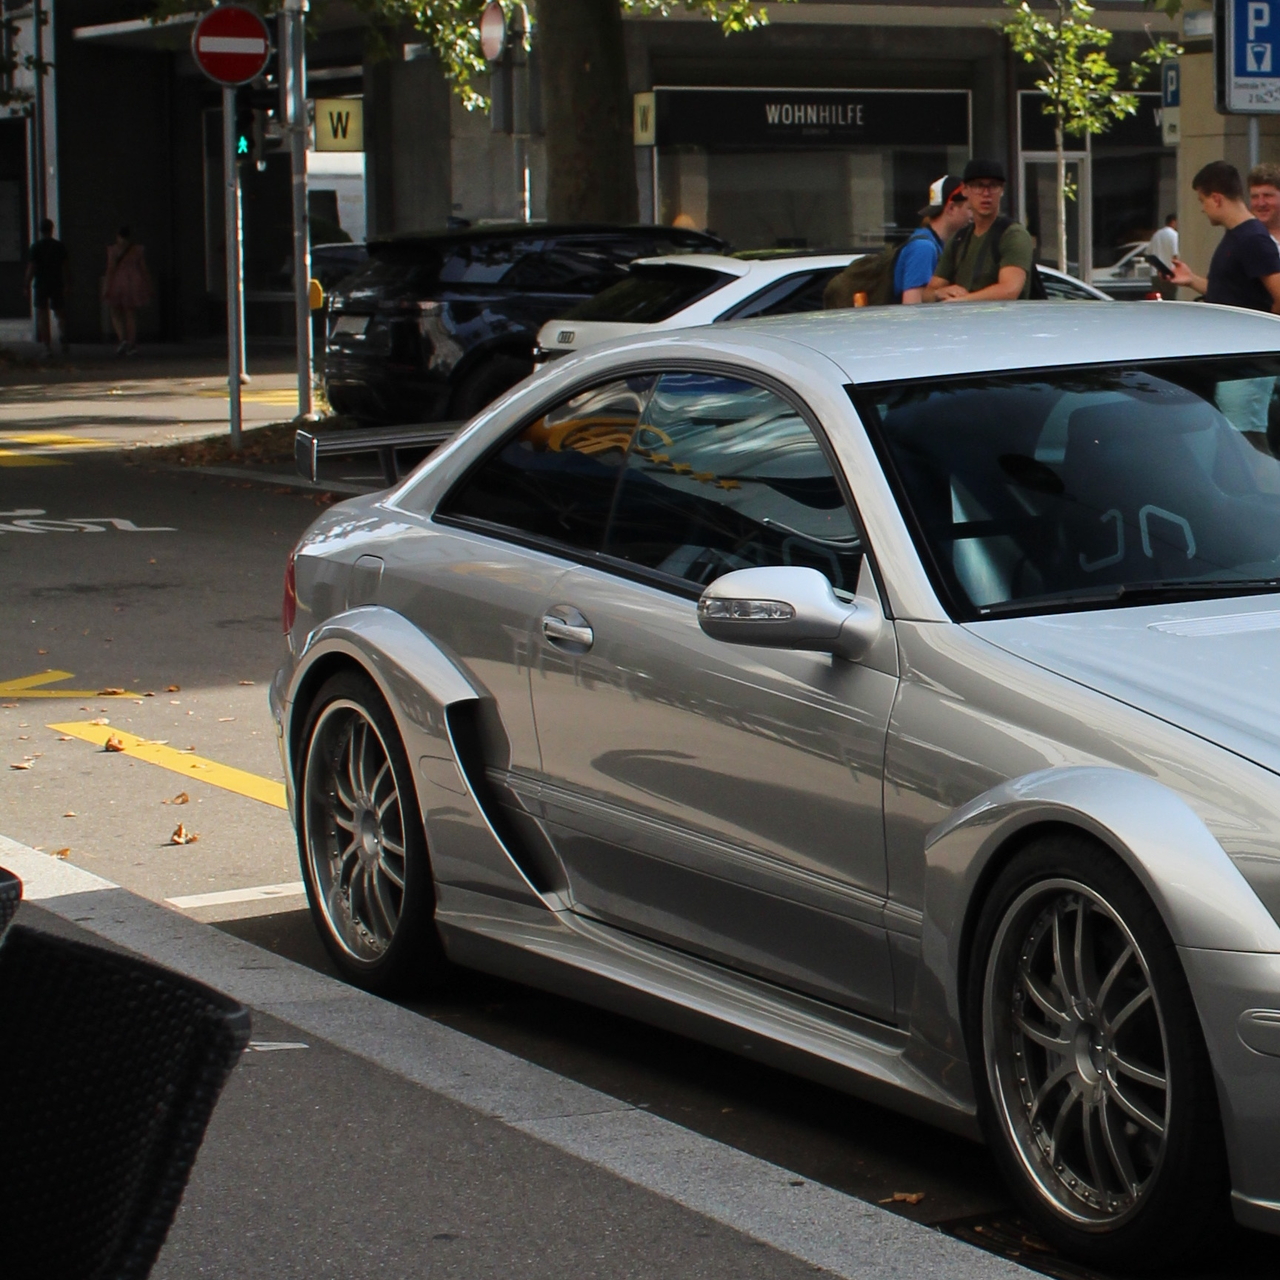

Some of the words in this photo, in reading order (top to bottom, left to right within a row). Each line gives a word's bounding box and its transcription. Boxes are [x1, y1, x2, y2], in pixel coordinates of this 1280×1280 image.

[1248, 2, 1270, 40] P
[1166, 69, 1178, 103] P
[328, 111, 350, 139] W
[638, 105, 650, 133] W
[765, 104, 864, 125] WOHNHILFE
